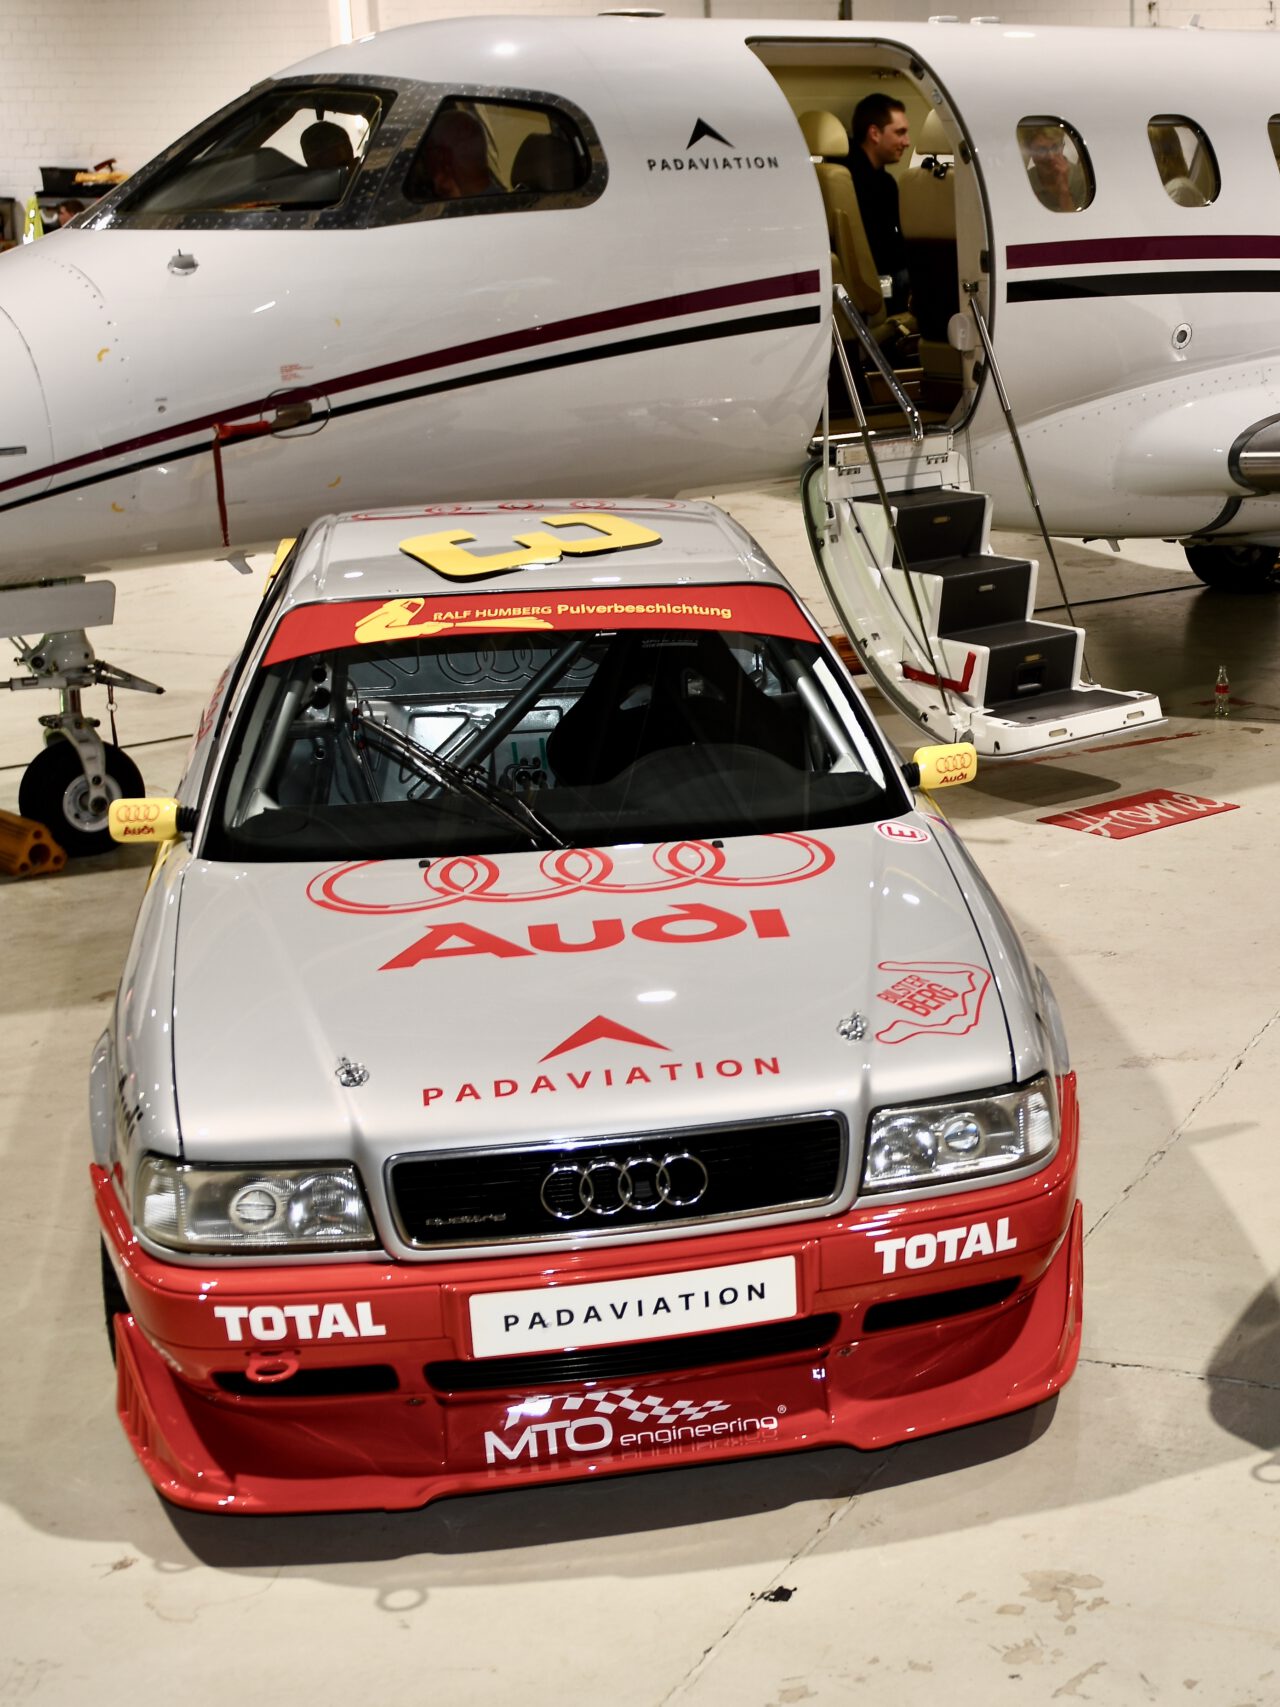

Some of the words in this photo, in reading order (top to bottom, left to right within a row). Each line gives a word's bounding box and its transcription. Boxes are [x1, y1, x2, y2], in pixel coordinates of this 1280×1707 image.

[646, 156, 779, 171] PADAVIATION
[433, 610, 472, 621] RALF
[475, 606, 552, 618] HUMBERG
[557, 603, 732, 619] Pulverbeschichtung
[377, 902, 791, 971] Audi
[897, 982, 959, 1017] BERG
[422, 1056, 781, 1107] PADAVIATION
[874, 1217, 1018, 1275] TOTAL
[213, 1301, 387, 1342] TOTAL
[503, 1282, 766, 1332] PADAVIATION
[484, 1416, 613, 1464] MTO
